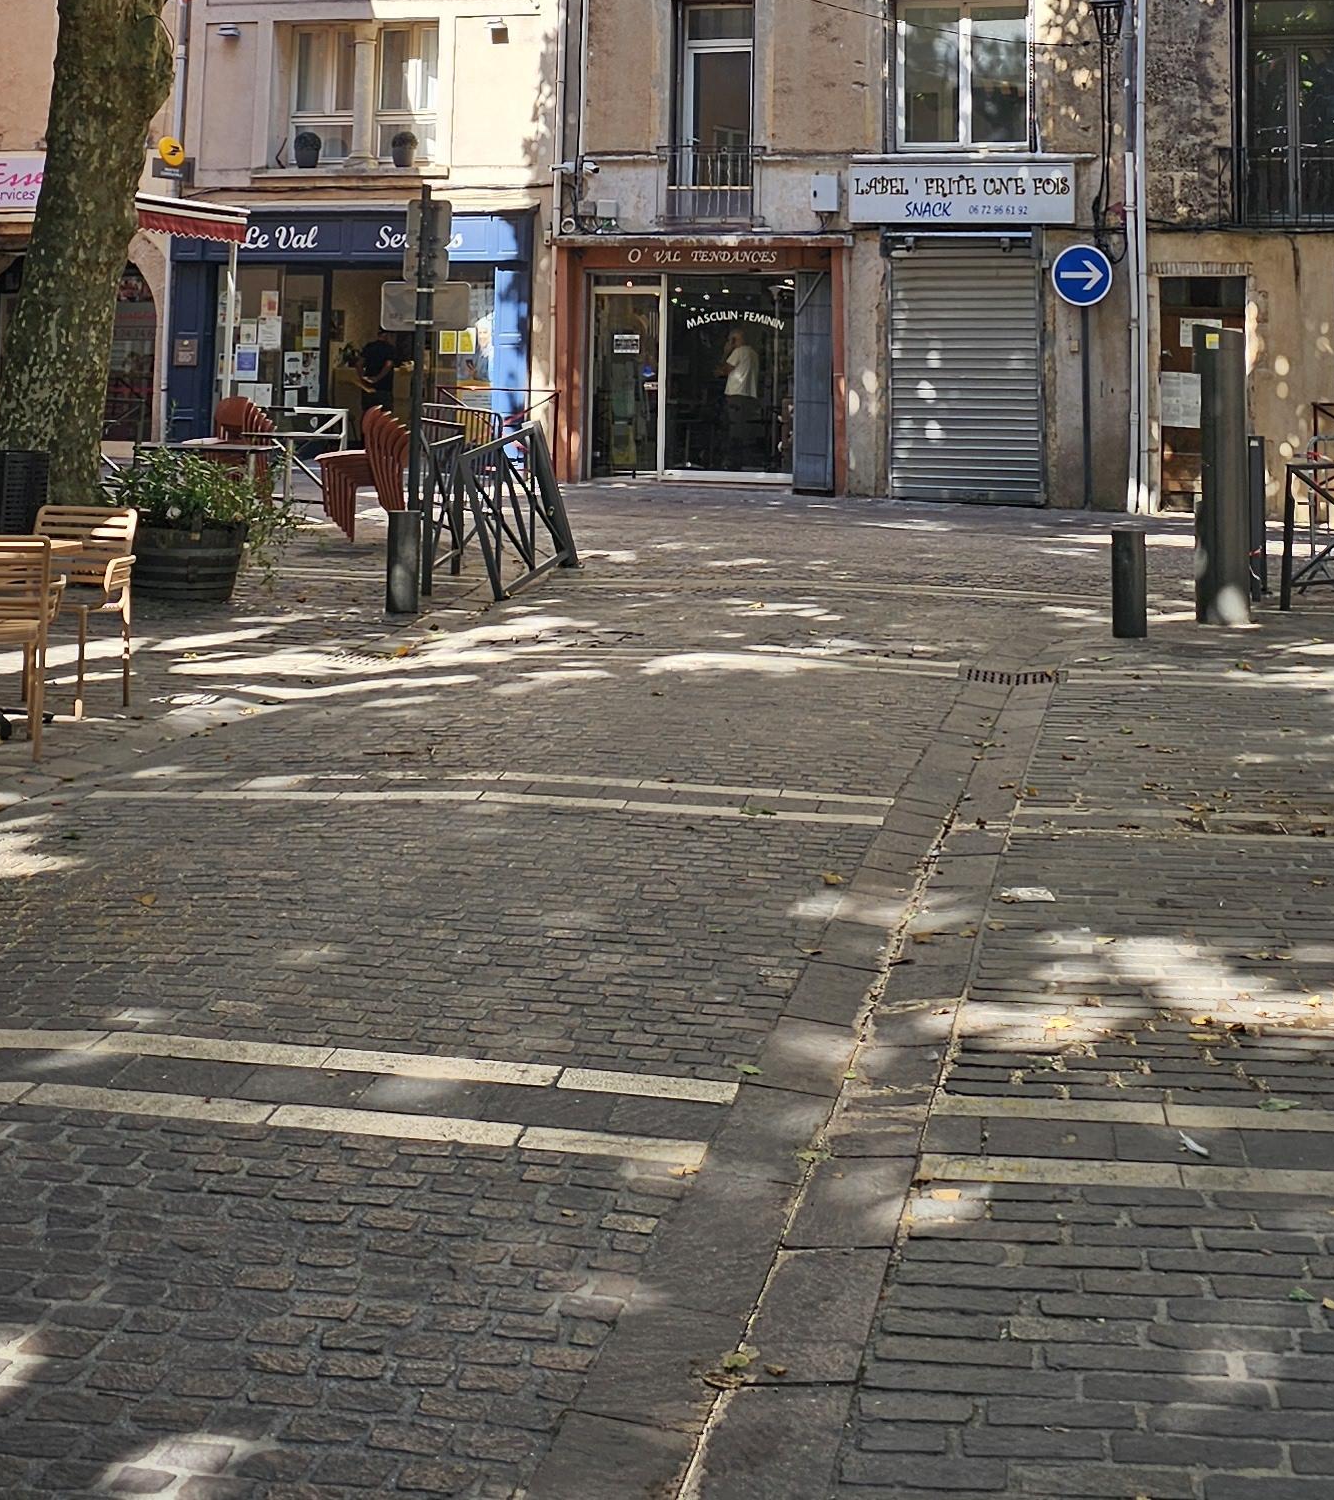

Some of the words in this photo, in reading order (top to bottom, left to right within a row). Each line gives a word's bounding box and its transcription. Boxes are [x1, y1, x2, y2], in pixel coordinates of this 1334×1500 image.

[854, 176, 909, 196] LABEL
[924, 175, 977, 198] FRITE
[983, 177, 1026, 196] UNE
[1033, 176, 1071, 196] FOIS
[905, 201, 952, 218] SNACK
[981, 204, 992, 215] 72
[240, 226, 270, 249] Le
[275, 225, 319, 249] Val
[375, 225, 464, 249] Sers
[653, 251, 682, 263] VAL
[691, 250, 778, 263] TENDANCES
